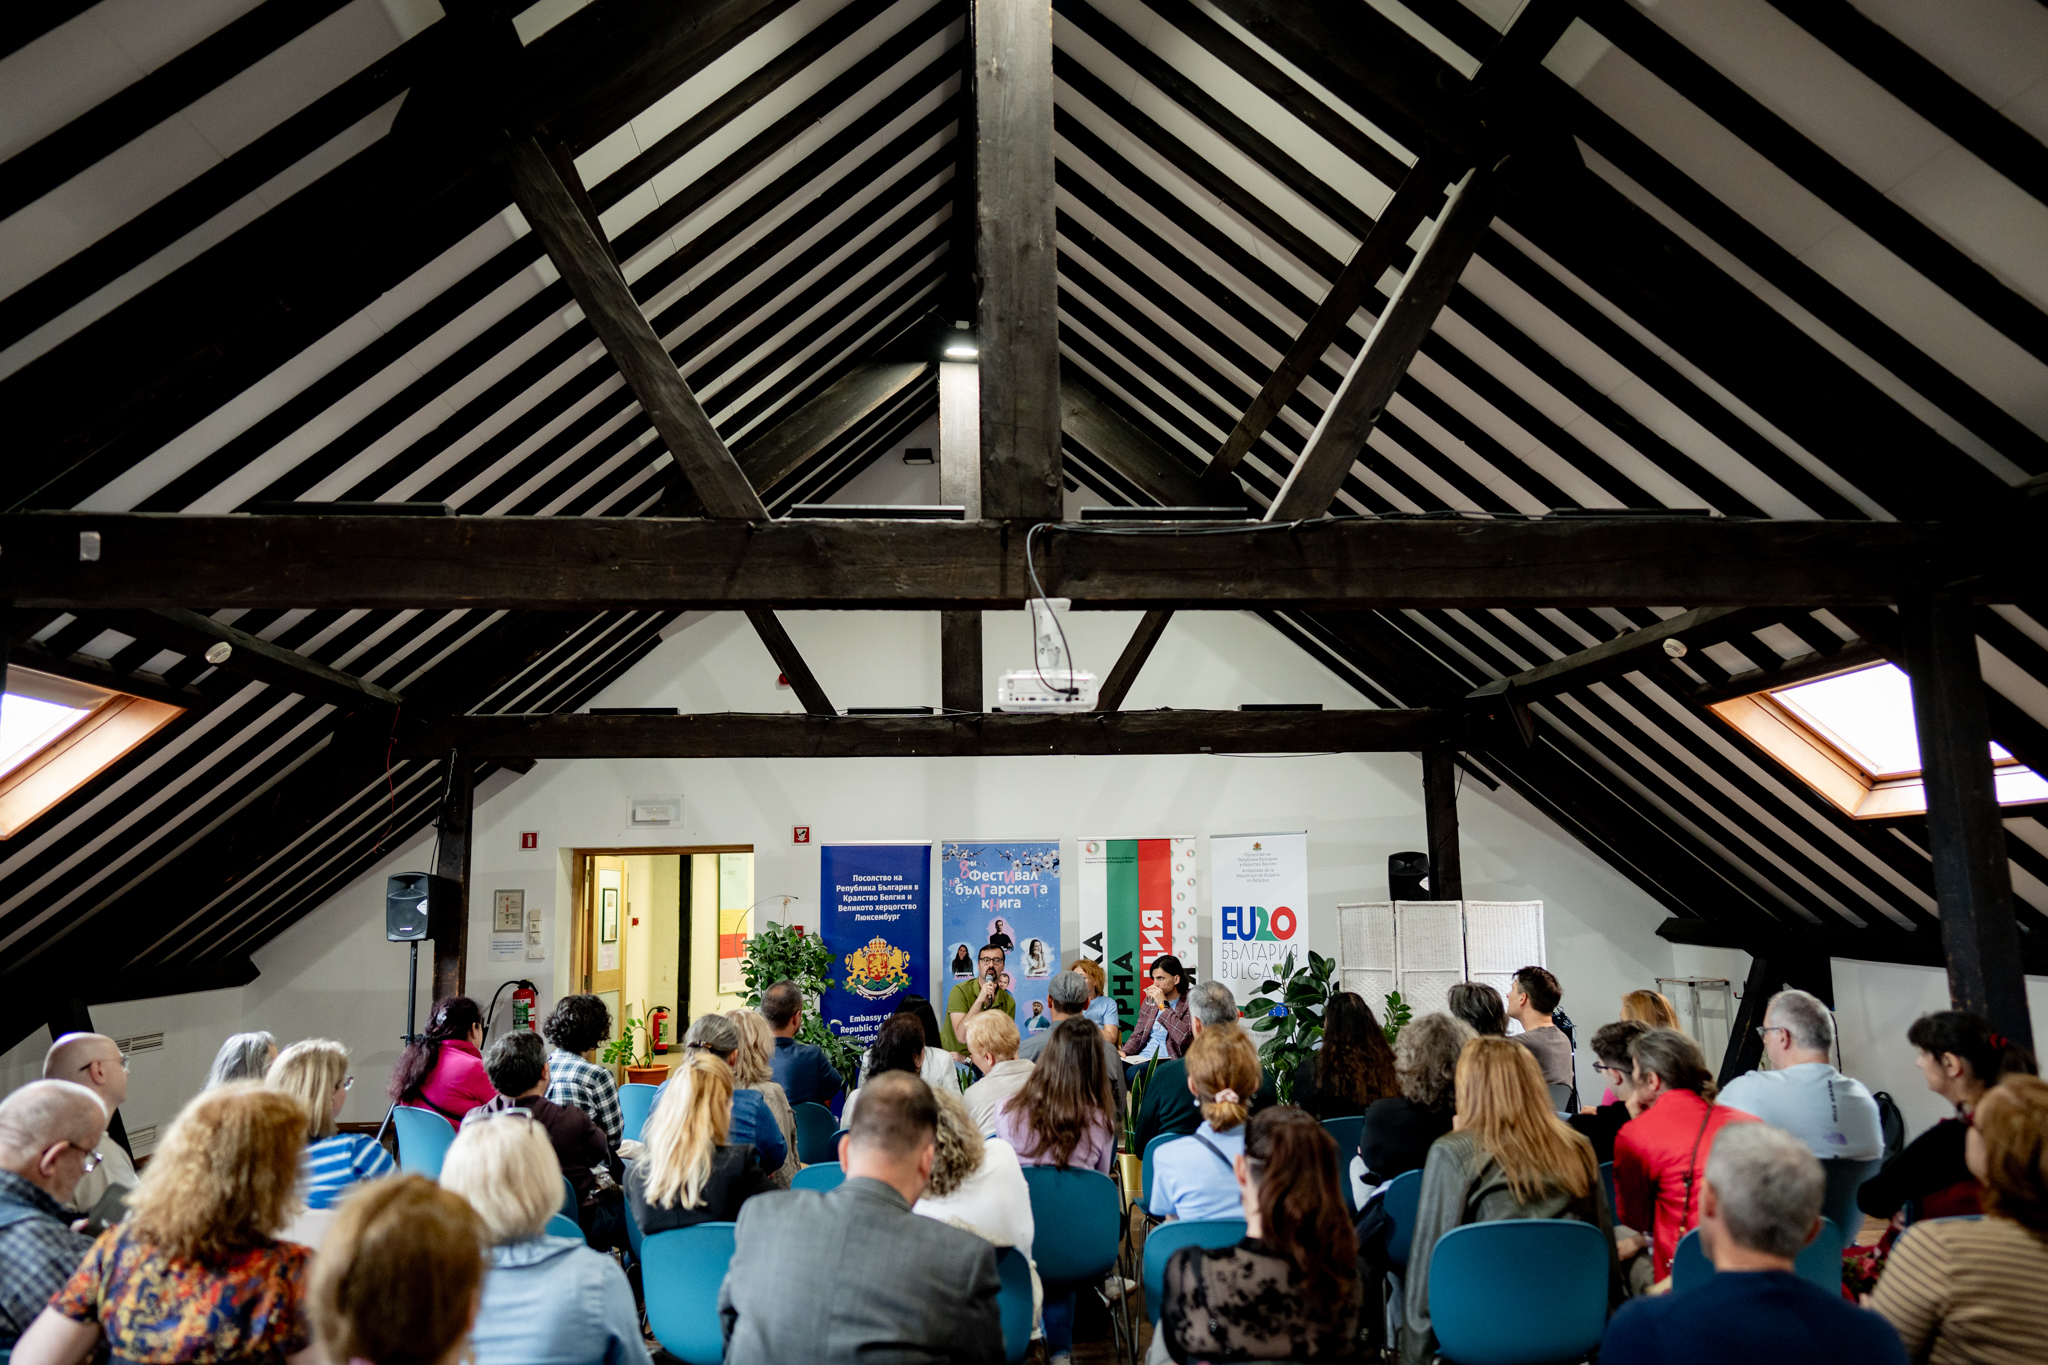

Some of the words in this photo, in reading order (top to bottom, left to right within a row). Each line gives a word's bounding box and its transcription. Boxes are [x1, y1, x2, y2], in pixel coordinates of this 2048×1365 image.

[853, 874, 892, 882] Посолство
[836, 884, 876, 893] Република
[878, 884, 913, 892] България
[843, 894, 878, 903] Кралство
[880, 893, 906, 901] Белгия
[838, 904, 874, 912] Великото
[875, 903, 917, 912] херцогство
[855, 912, 900, 921] Люксембург
[1221, 906, 1297, 941] EU20
[1222, 942, 1298, 961] БЪЛГАРИЯ
[849, 1014, 882, 1023] Embassy
[883, 1012, 892, 1020] of
[840, 1023, 873, 1034] Republic
[855, 1034, 878, 1043] ingdo
